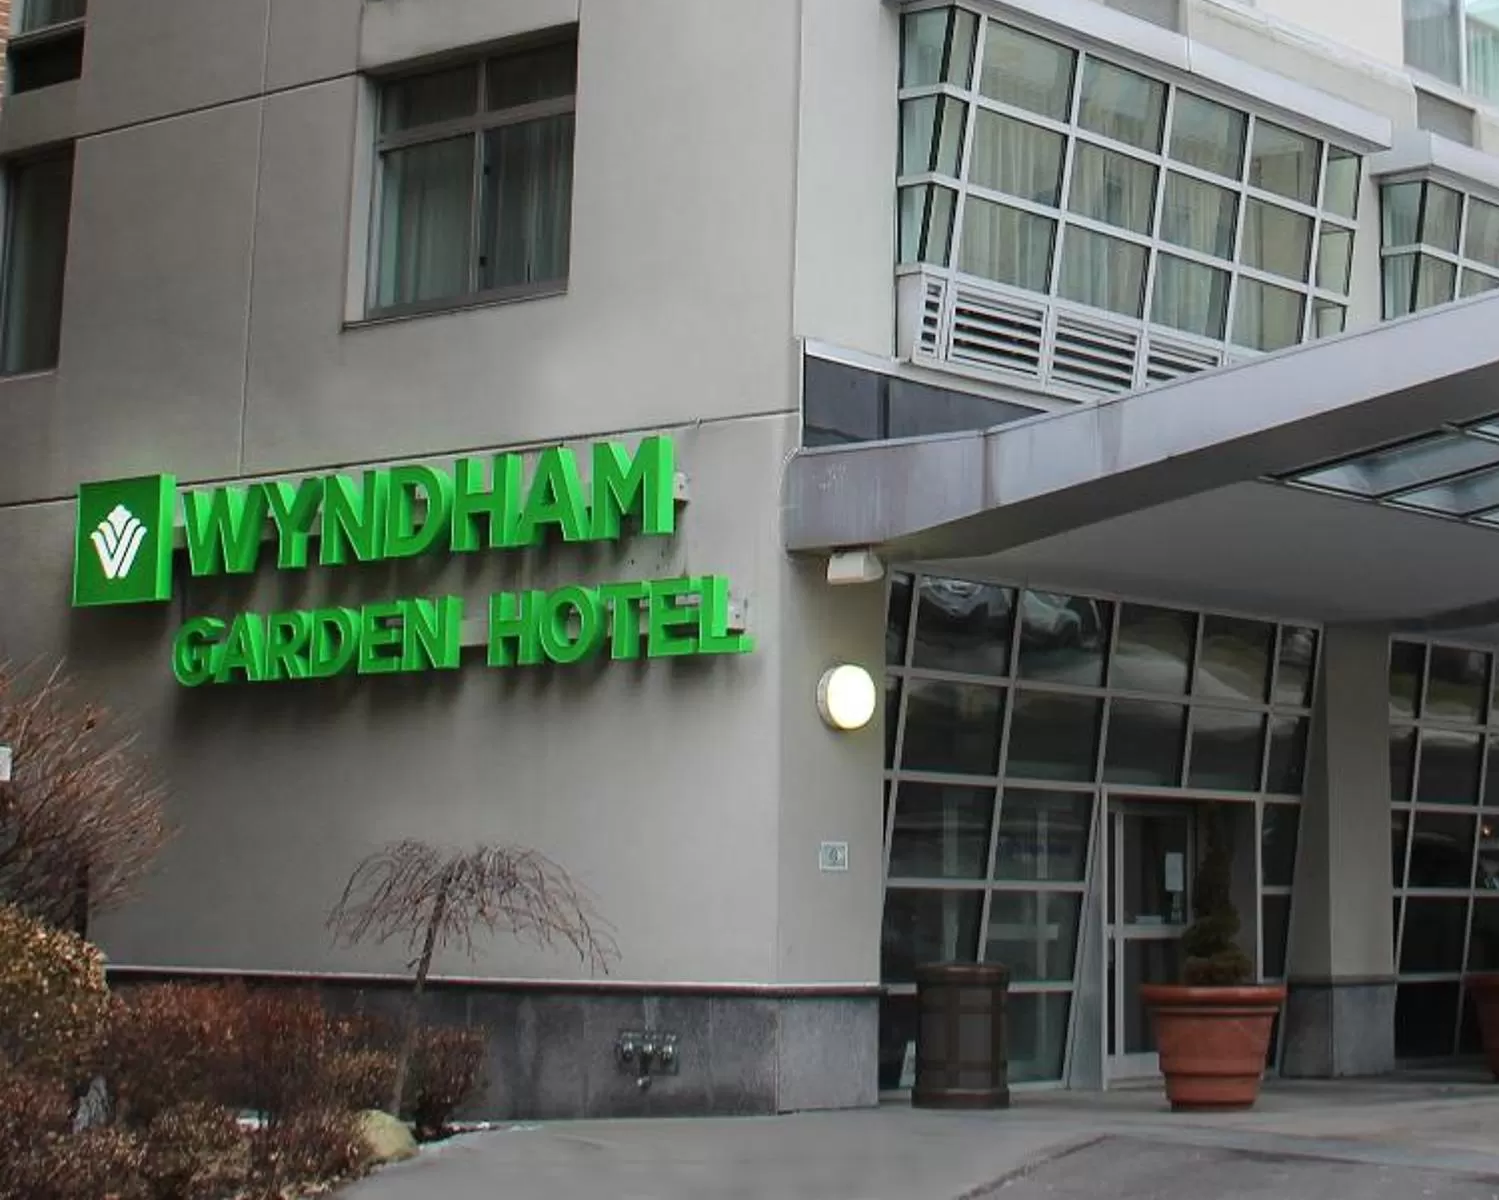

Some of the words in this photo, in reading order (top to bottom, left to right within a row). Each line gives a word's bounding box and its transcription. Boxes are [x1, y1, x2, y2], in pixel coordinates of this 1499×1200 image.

[183, 435, 675, 577] WYNDHAM
[171, 595, 461, 687] GARDEN
[487, 574, 755, 667] HOTEL
